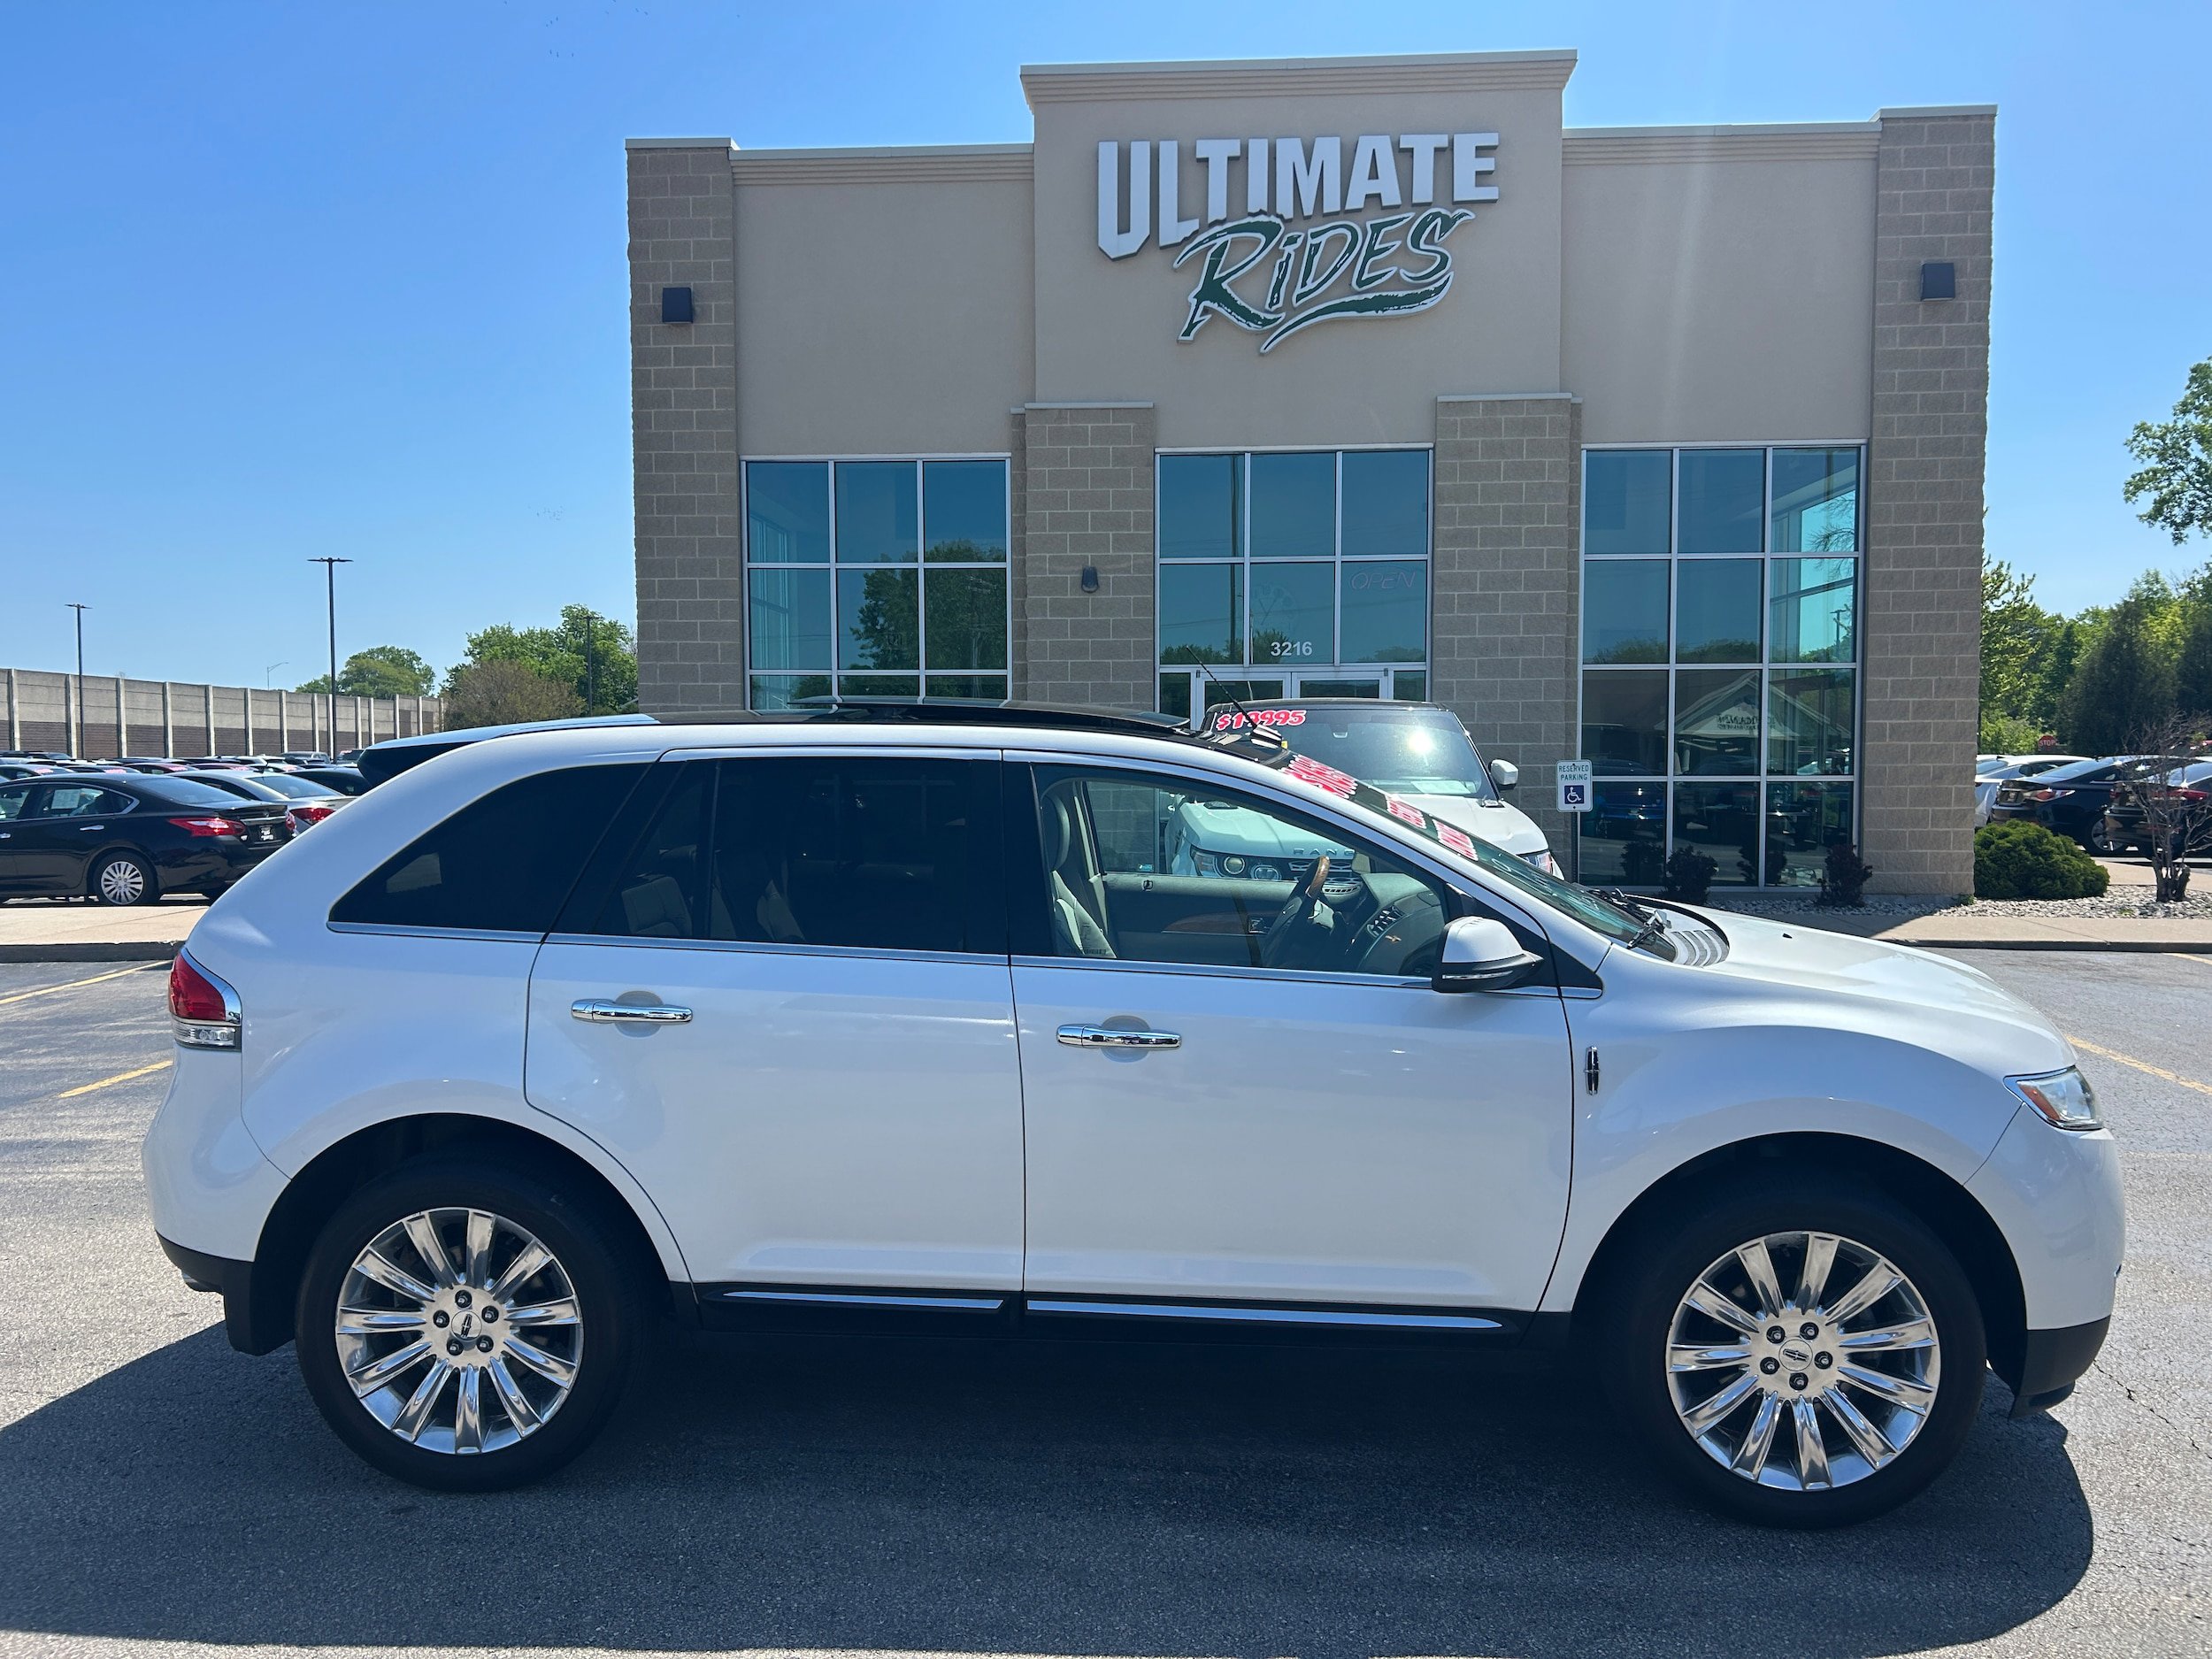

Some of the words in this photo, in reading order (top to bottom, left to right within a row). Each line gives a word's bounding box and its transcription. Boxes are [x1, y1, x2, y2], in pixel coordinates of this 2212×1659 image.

[1098, 132, 1500, 260] ULTIMATE
[1351, 571, 1416, 589] OPEN
[1271, 641, 1313, 657] 3216
